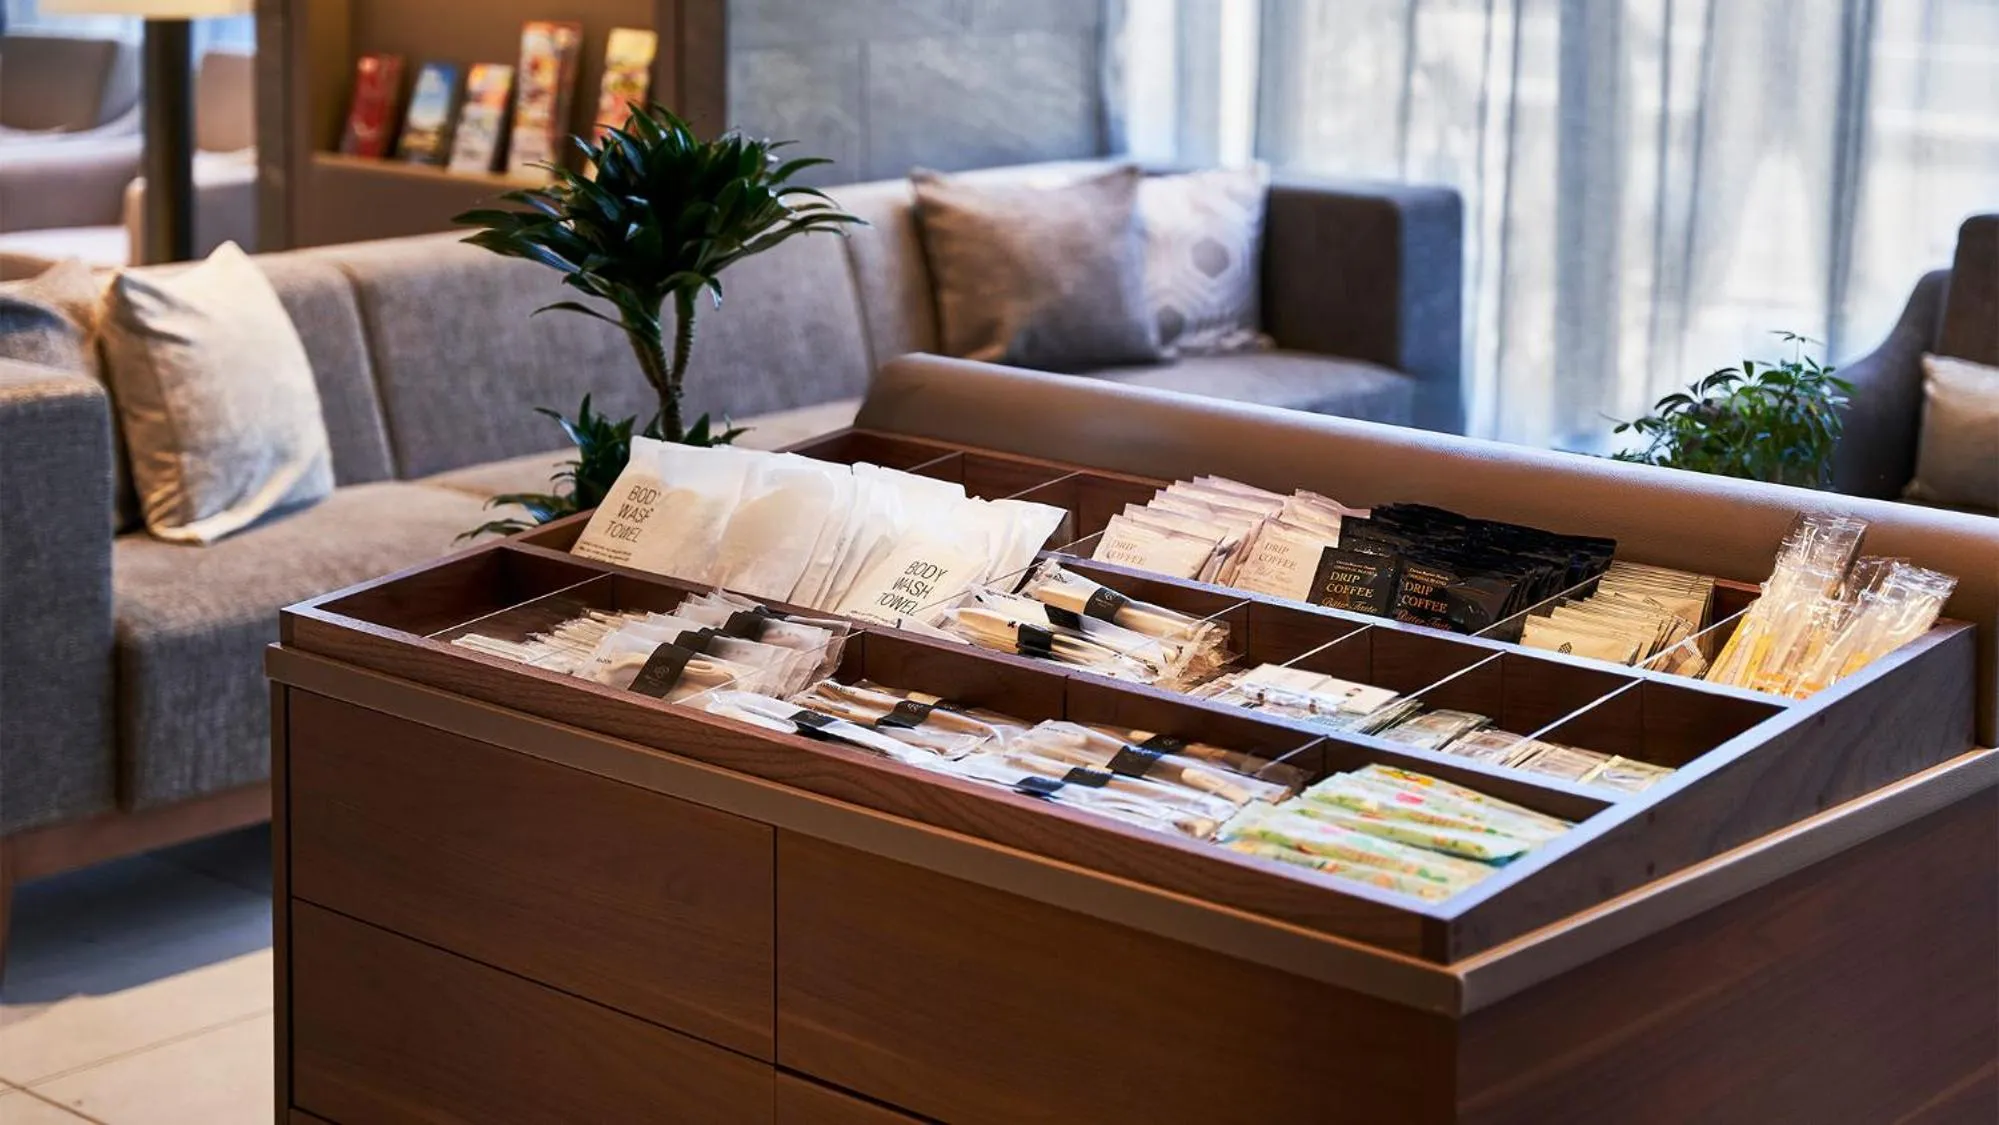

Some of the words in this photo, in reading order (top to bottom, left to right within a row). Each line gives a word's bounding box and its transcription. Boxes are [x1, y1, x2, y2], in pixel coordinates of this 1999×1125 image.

[628, 485, 661, 505] BOD
[604, 520, 642, 543] TOWEL
[904, 561, 948, 582] BODY
[1330, 571, 1360, 583] DRIP
[892, 577, 934, 599] WASH
[1326, 583, 1375, 598] COFFEE
[1405, 582, 1433, 595] DRIP
[874, 592, 918, 616] TOWEL
[1401, 594, 1449, 613] COFFEE
